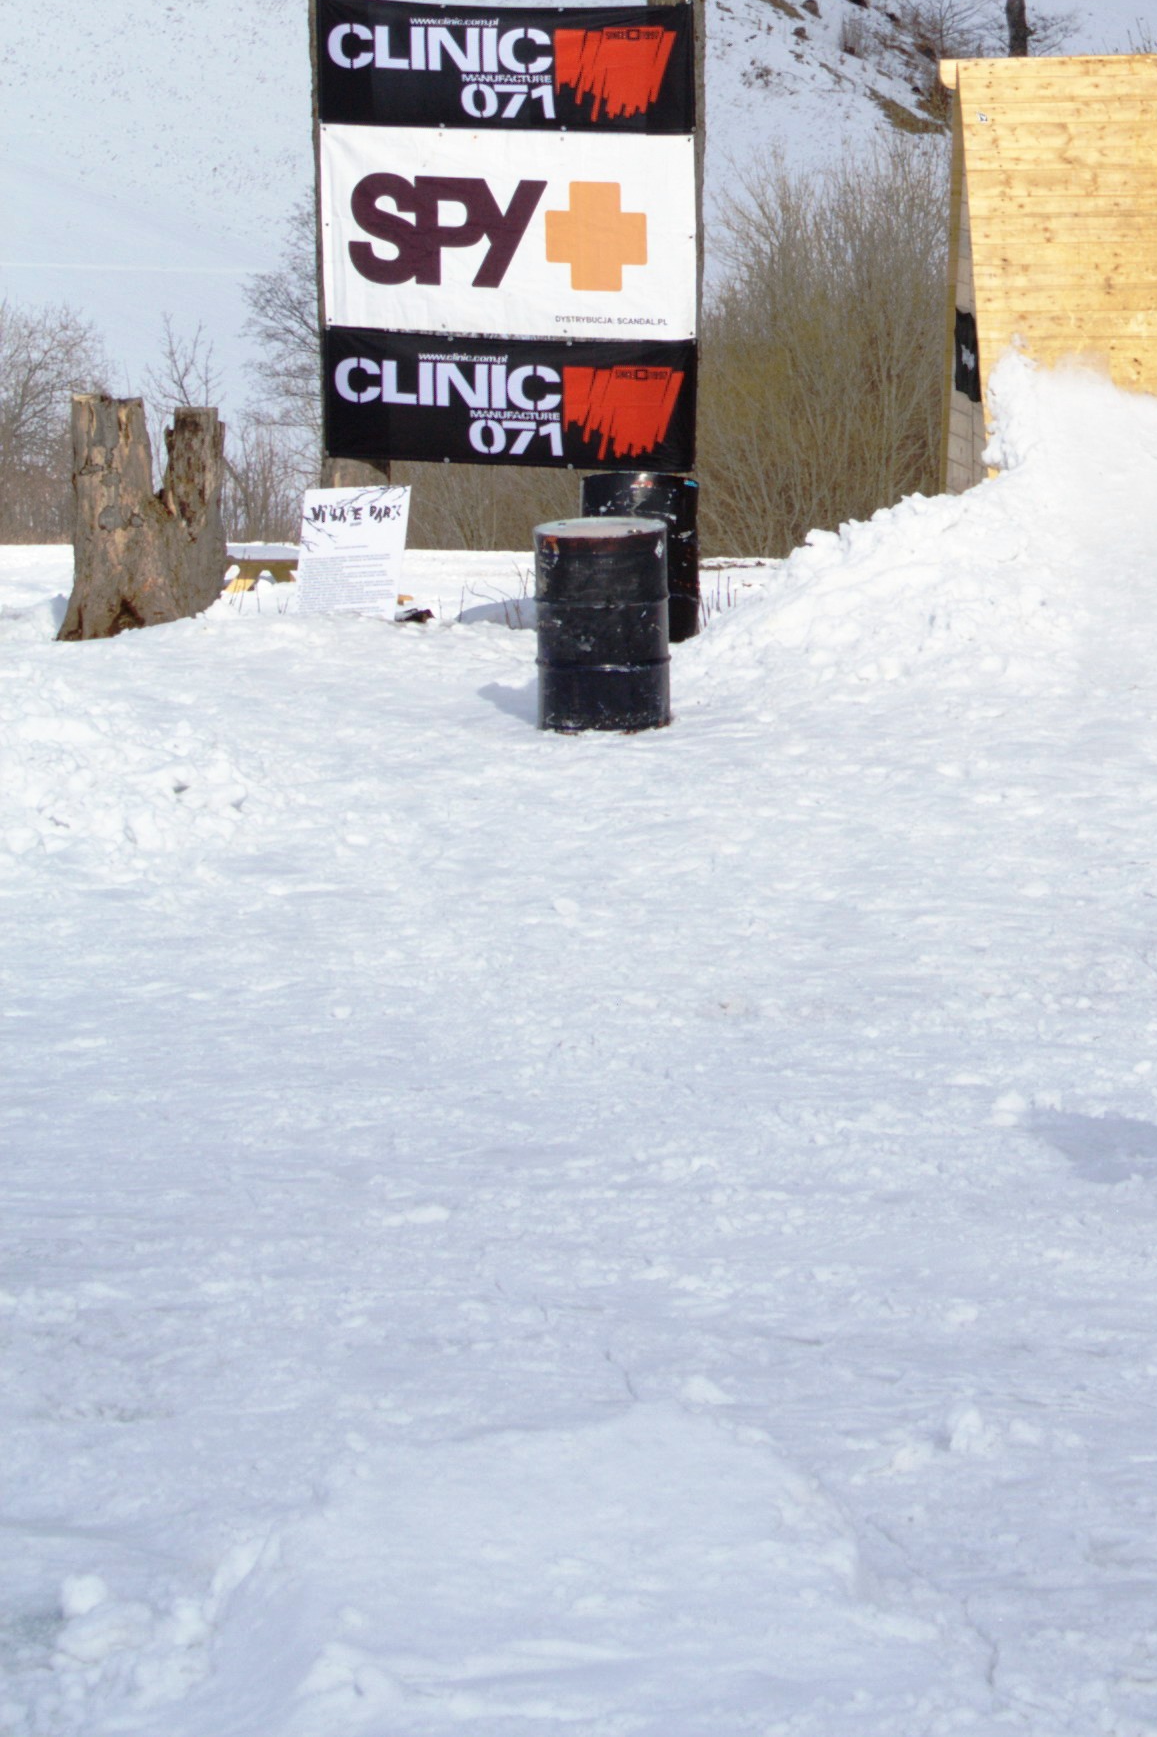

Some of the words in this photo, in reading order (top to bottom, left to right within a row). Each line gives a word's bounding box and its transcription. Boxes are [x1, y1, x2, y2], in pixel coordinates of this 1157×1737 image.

[409, 17, 499, 27] www.clinic.com.pl
[327, 23, 553, 74] CLINIC
[461, 73, 552, 84] MANUFACTURE
[460, 83, 556, 120] 071
[348, 172, 548, 289] SPY
[617, 317, 668, 326] SCANDAL.PL
[418, 352, 508, 364] www.clinic.com.pl
[334, 356, 562, 411] CLINIC
[470, 410, 561, 421] MANUFACTURE
[468, 419, 563, 457] 071
